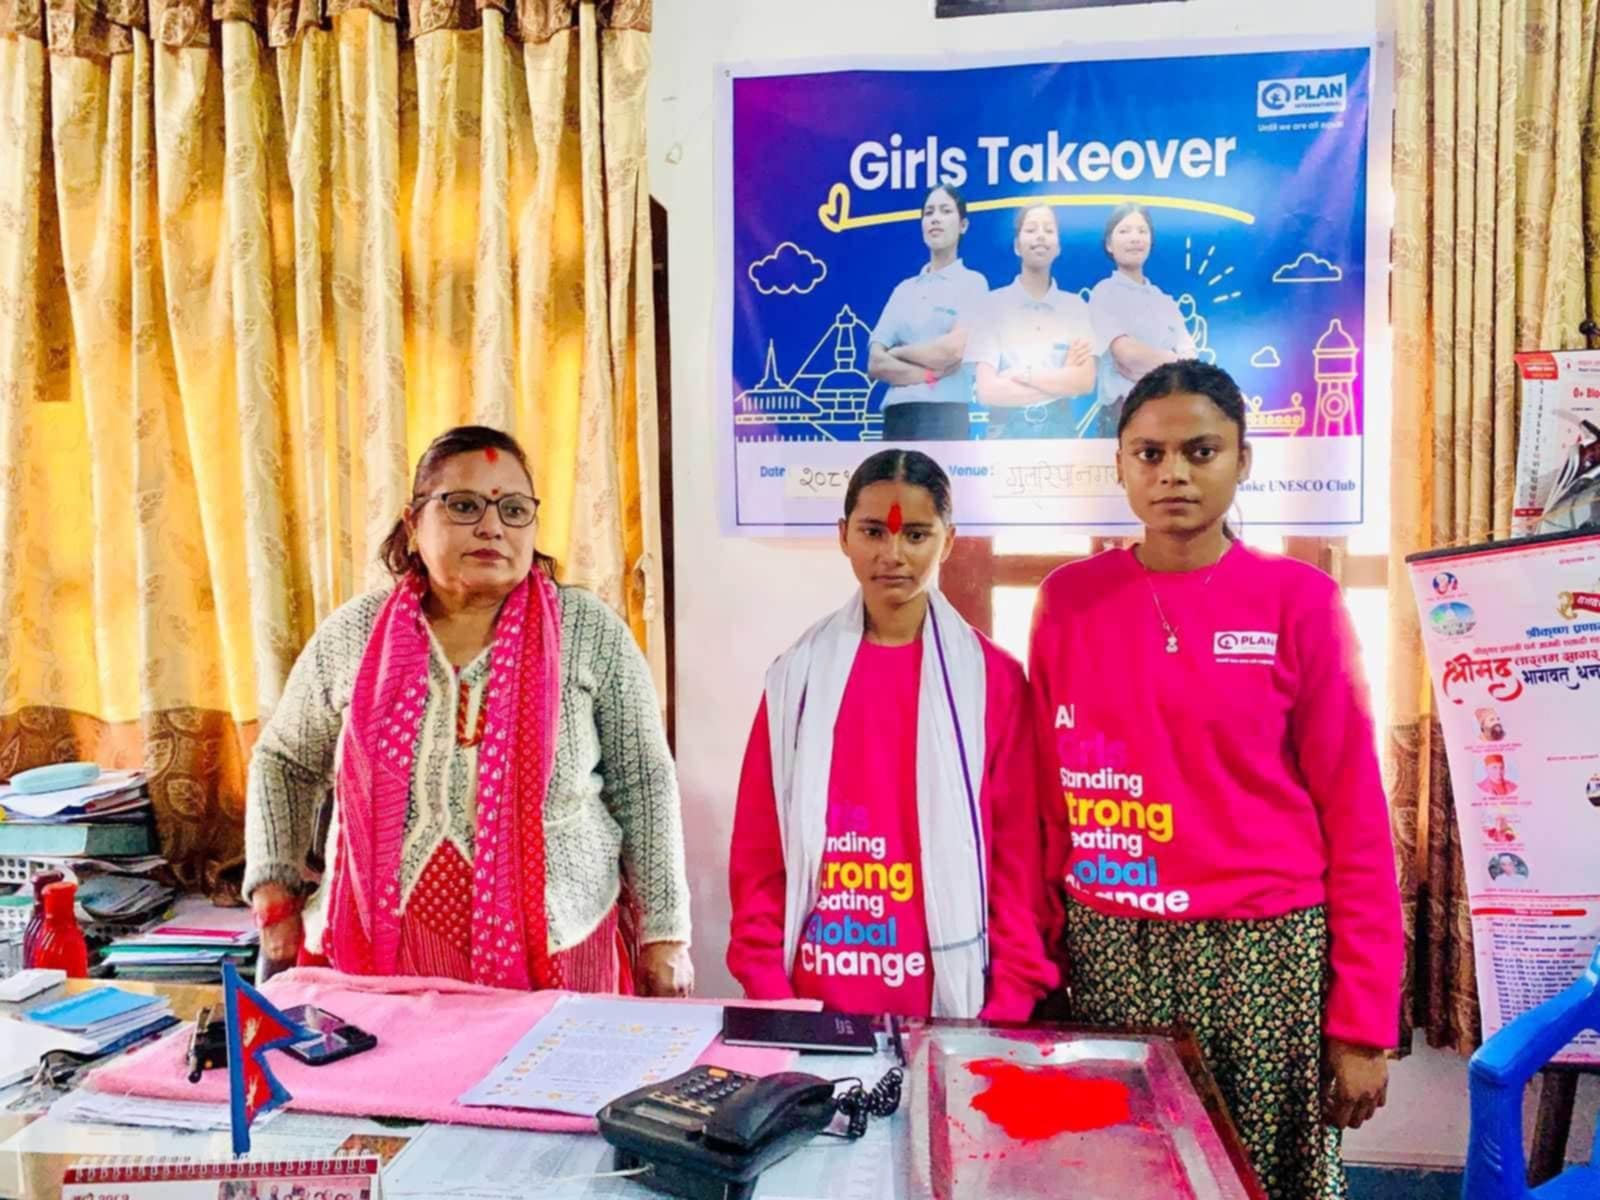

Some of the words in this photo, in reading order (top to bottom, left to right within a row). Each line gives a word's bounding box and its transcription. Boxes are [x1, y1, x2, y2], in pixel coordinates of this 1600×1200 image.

[1294, 83, 1342, 100] PLAN
[849, 133, 967, 191] Girls
[977, 130, 1237, 185] Takeover
[1269, 480, 1323, 492] UNESCO
[1326, 480, 1356, 492] Club
[1241, 636, 1275, 647] PLAN
[801, 942, 926, 988] Change
